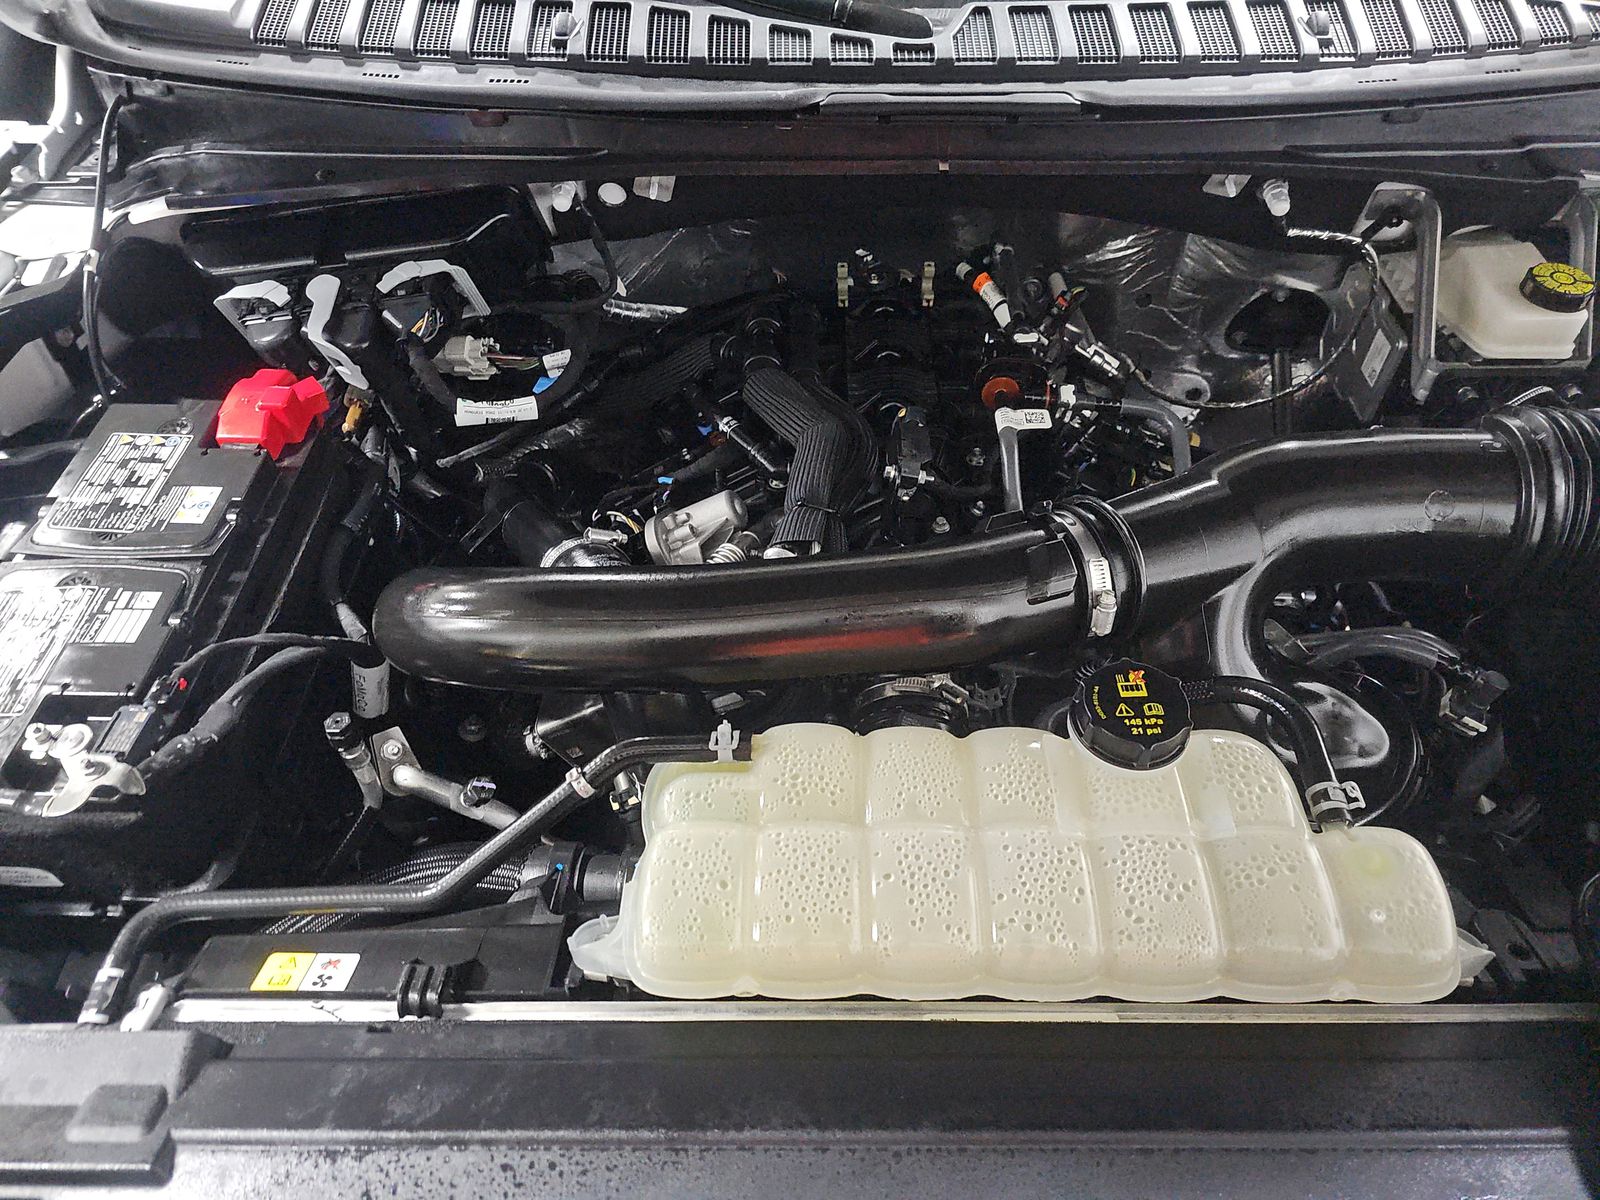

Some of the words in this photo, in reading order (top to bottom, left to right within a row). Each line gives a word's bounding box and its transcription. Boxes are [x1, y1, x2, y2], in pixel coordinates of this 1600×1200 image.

[1123, 718, 1142, 726] 145
[1144, 717, 1164, 726] kPa
[1131, 727, 1144, 735] 21
[1146, 726, 1162, 736] psi
